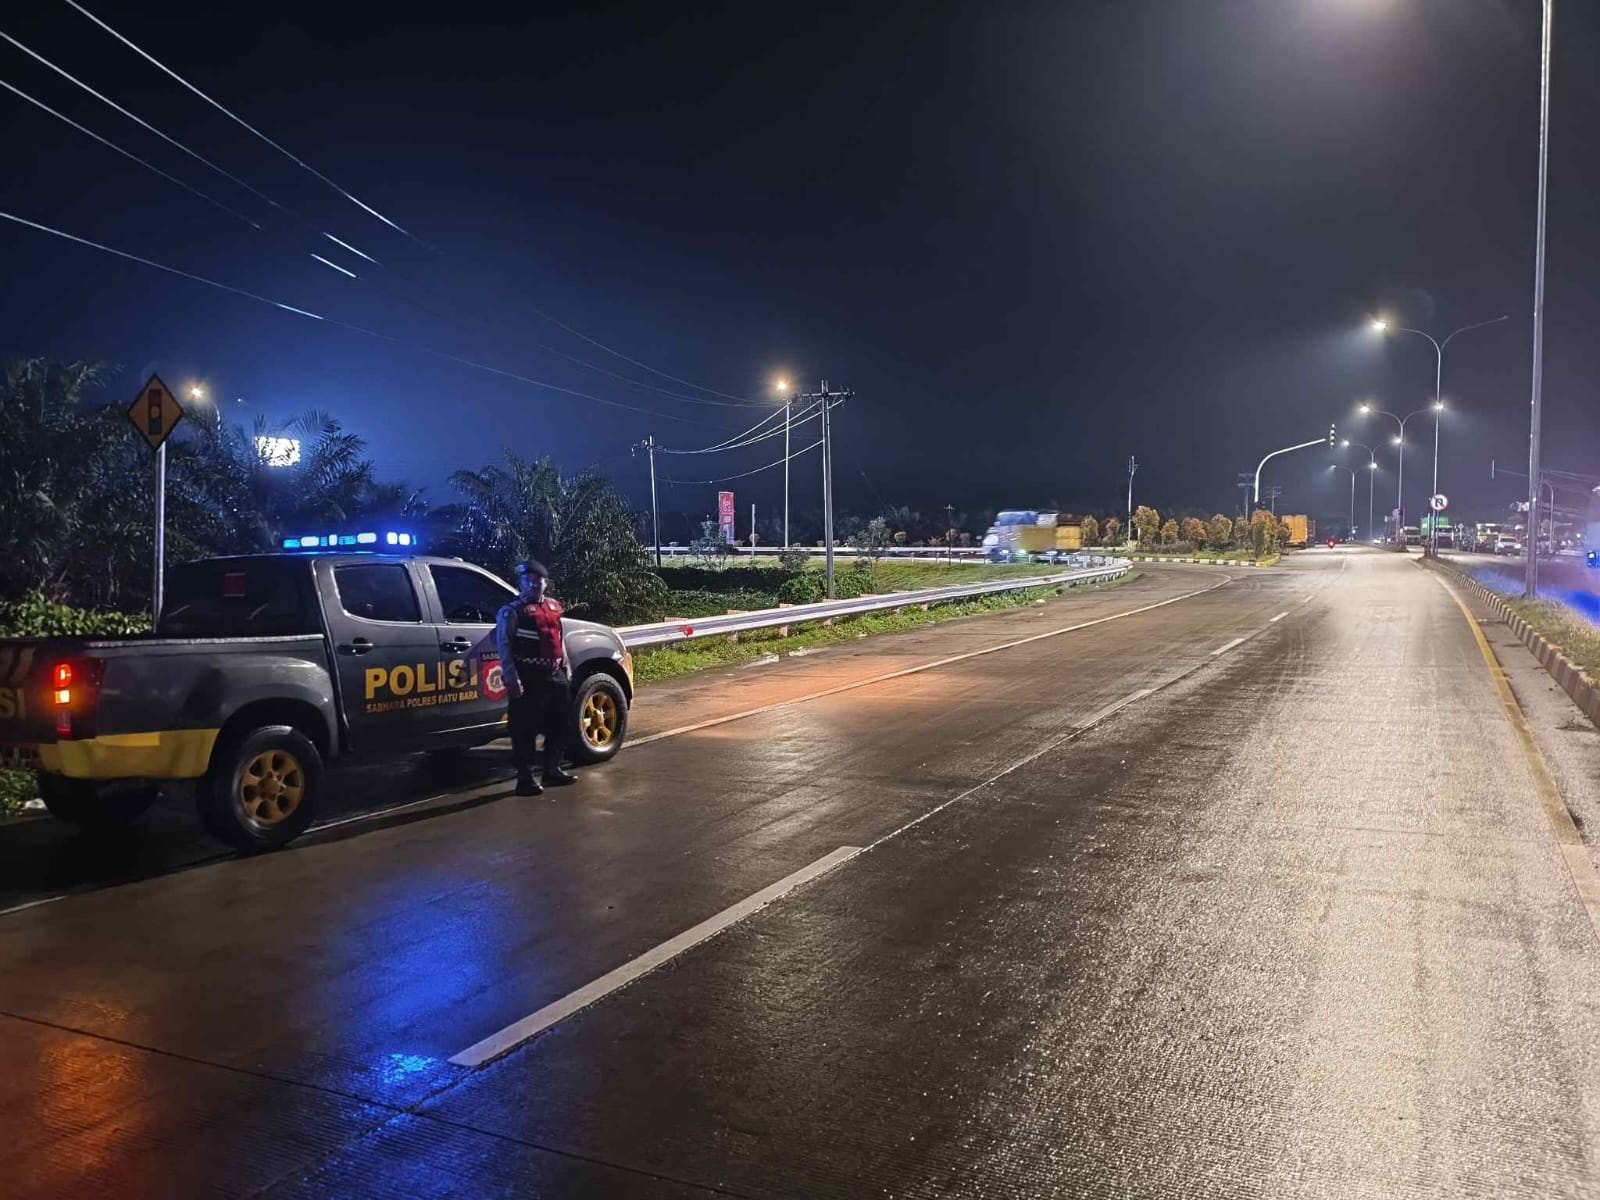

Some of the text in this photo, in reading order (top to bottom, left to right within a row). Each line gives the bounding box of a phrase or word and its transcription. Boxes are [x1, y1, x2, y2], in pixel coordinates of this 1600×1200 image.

[365, 659, 478, 699] POLISI
[407, 695, 437, 708] POLRES
[438, 692, 458, 704] BATU
[459, 690, 479, 701] BARA
